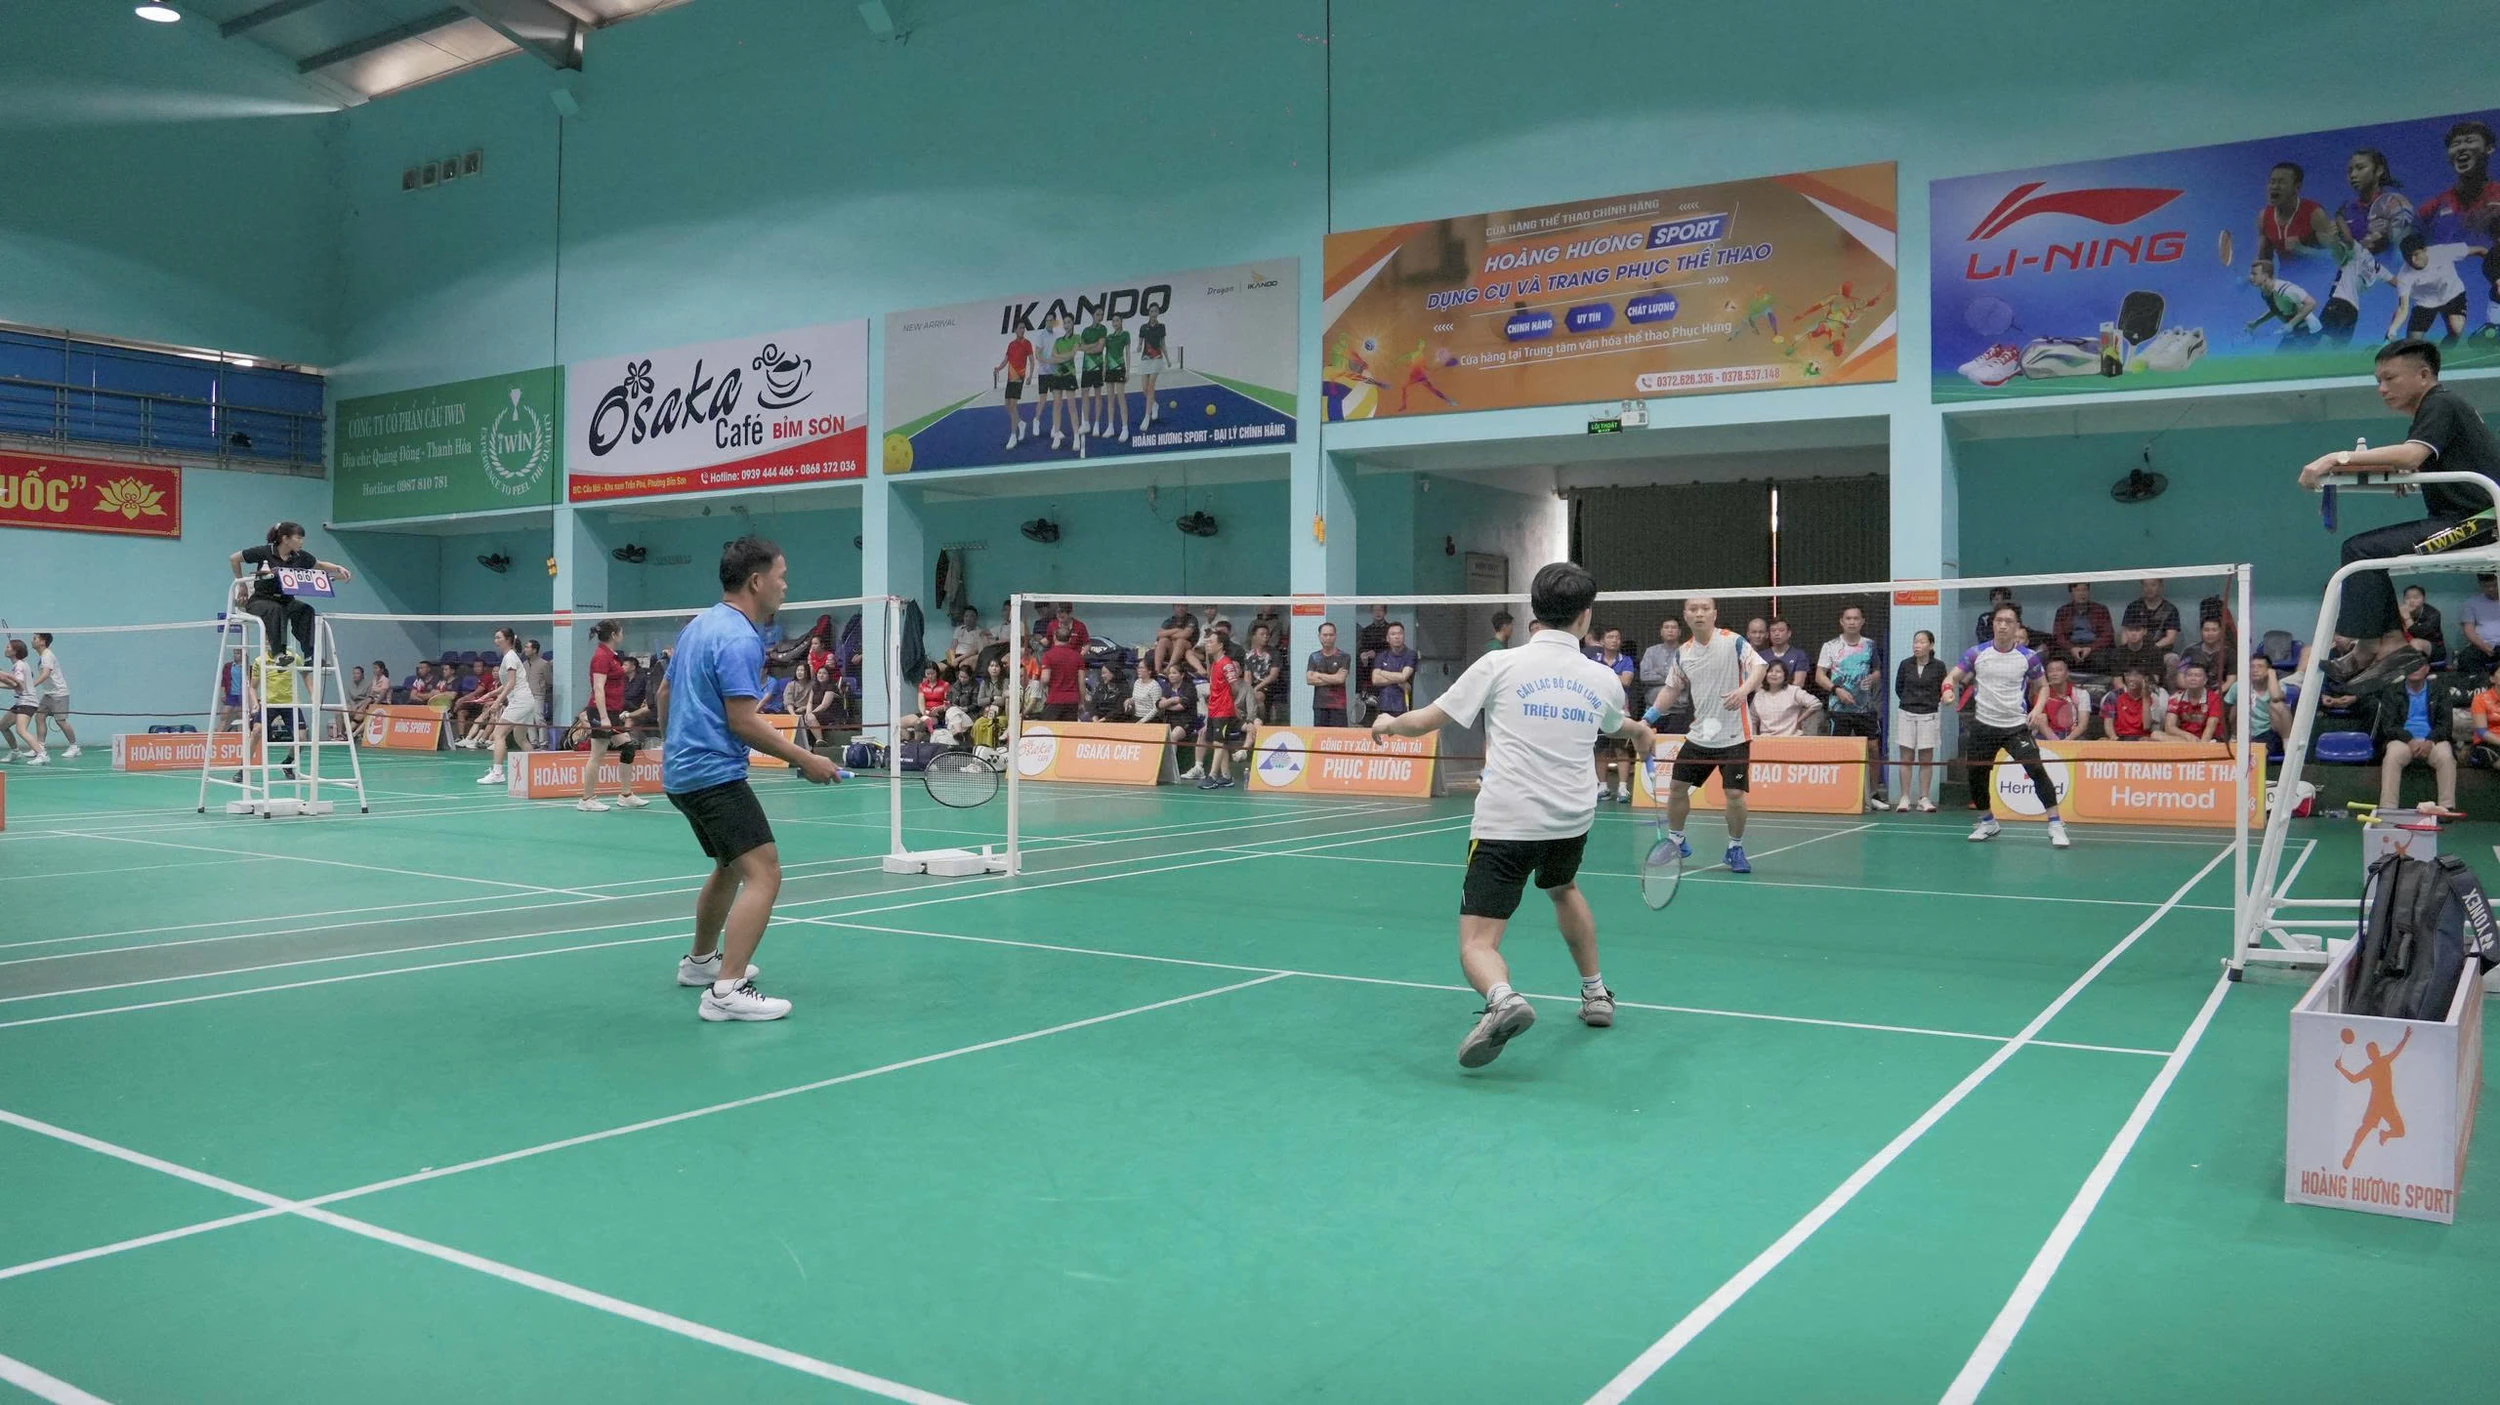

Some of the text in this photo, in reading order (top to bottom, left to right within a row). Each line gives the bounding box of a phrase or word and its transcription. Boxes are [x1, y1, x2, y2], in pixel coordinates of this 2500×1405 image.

[1562, 212, 1590, 224] THAO
[1593, 205, 1627, 219] CHÍNH
[1484, 219, 1720, 273] HOÀNG HƯƠNG SPORT
[1966, 232, 2188, 280] LI-NING
[1426, 243, 1773, 312] DỤNG CỤ VÀ TRANG PHỤC THỂ THAO
[1001, 284, 1172, 334] IKANDO
[1577, 313, 1589, 325] UY
[1481, 349, 1506, 365] hàng
[1524, 345, 1553, 360] Trung
[1556, 341, 1577, 353] tâm
[1645, 330, 1669, 343] thao
[589, 359, 742, 456] Osaka
[716, 413, 845, 449] Café BỈM SƠN
[1132, 432, 1157, 448] HOÀNG
[1158, 432, 1182, 446] HƯƠNG
[1184, 429, 1208, 443] SPORT
[1239, 423, 1263, 438] CHÍNH
[427, 441, 452, 458] Thanh
[711, 471, 740, 484] Hotline:
[741, 469, 760, 480] 0939
[762, 467, 777, 478] 444
[779, 466, 794, 477] 466
[801, 463, 820, 475] 0868
[823, 462, 838, 473] 372
[840, 460, 856, 472] 036
[1536, 677, 1551, 692] LẠC
[1523, 703, 1594, 724] TRIỆU SƠN 4
[131, 742, 172, 761] HOÀNG
[1076, 743, 1141, 761] OSAKA CAFE
[1344, 740, 1353, 751] TY
[534, 762, 577, 786] HOÀNG
[1323, 757, 1412, 785] PHỤC HƯNG
[1787, 765, 1840, 785] SPORT
[2124, 763, 2172, 781] TRANG
[2111, 785, 2215, 809] Hermod
[2462, 888, 2491, 937] YONEX
[2301, 1166, 2453, 1214] HOÀNG HƯƠNG SPORT
